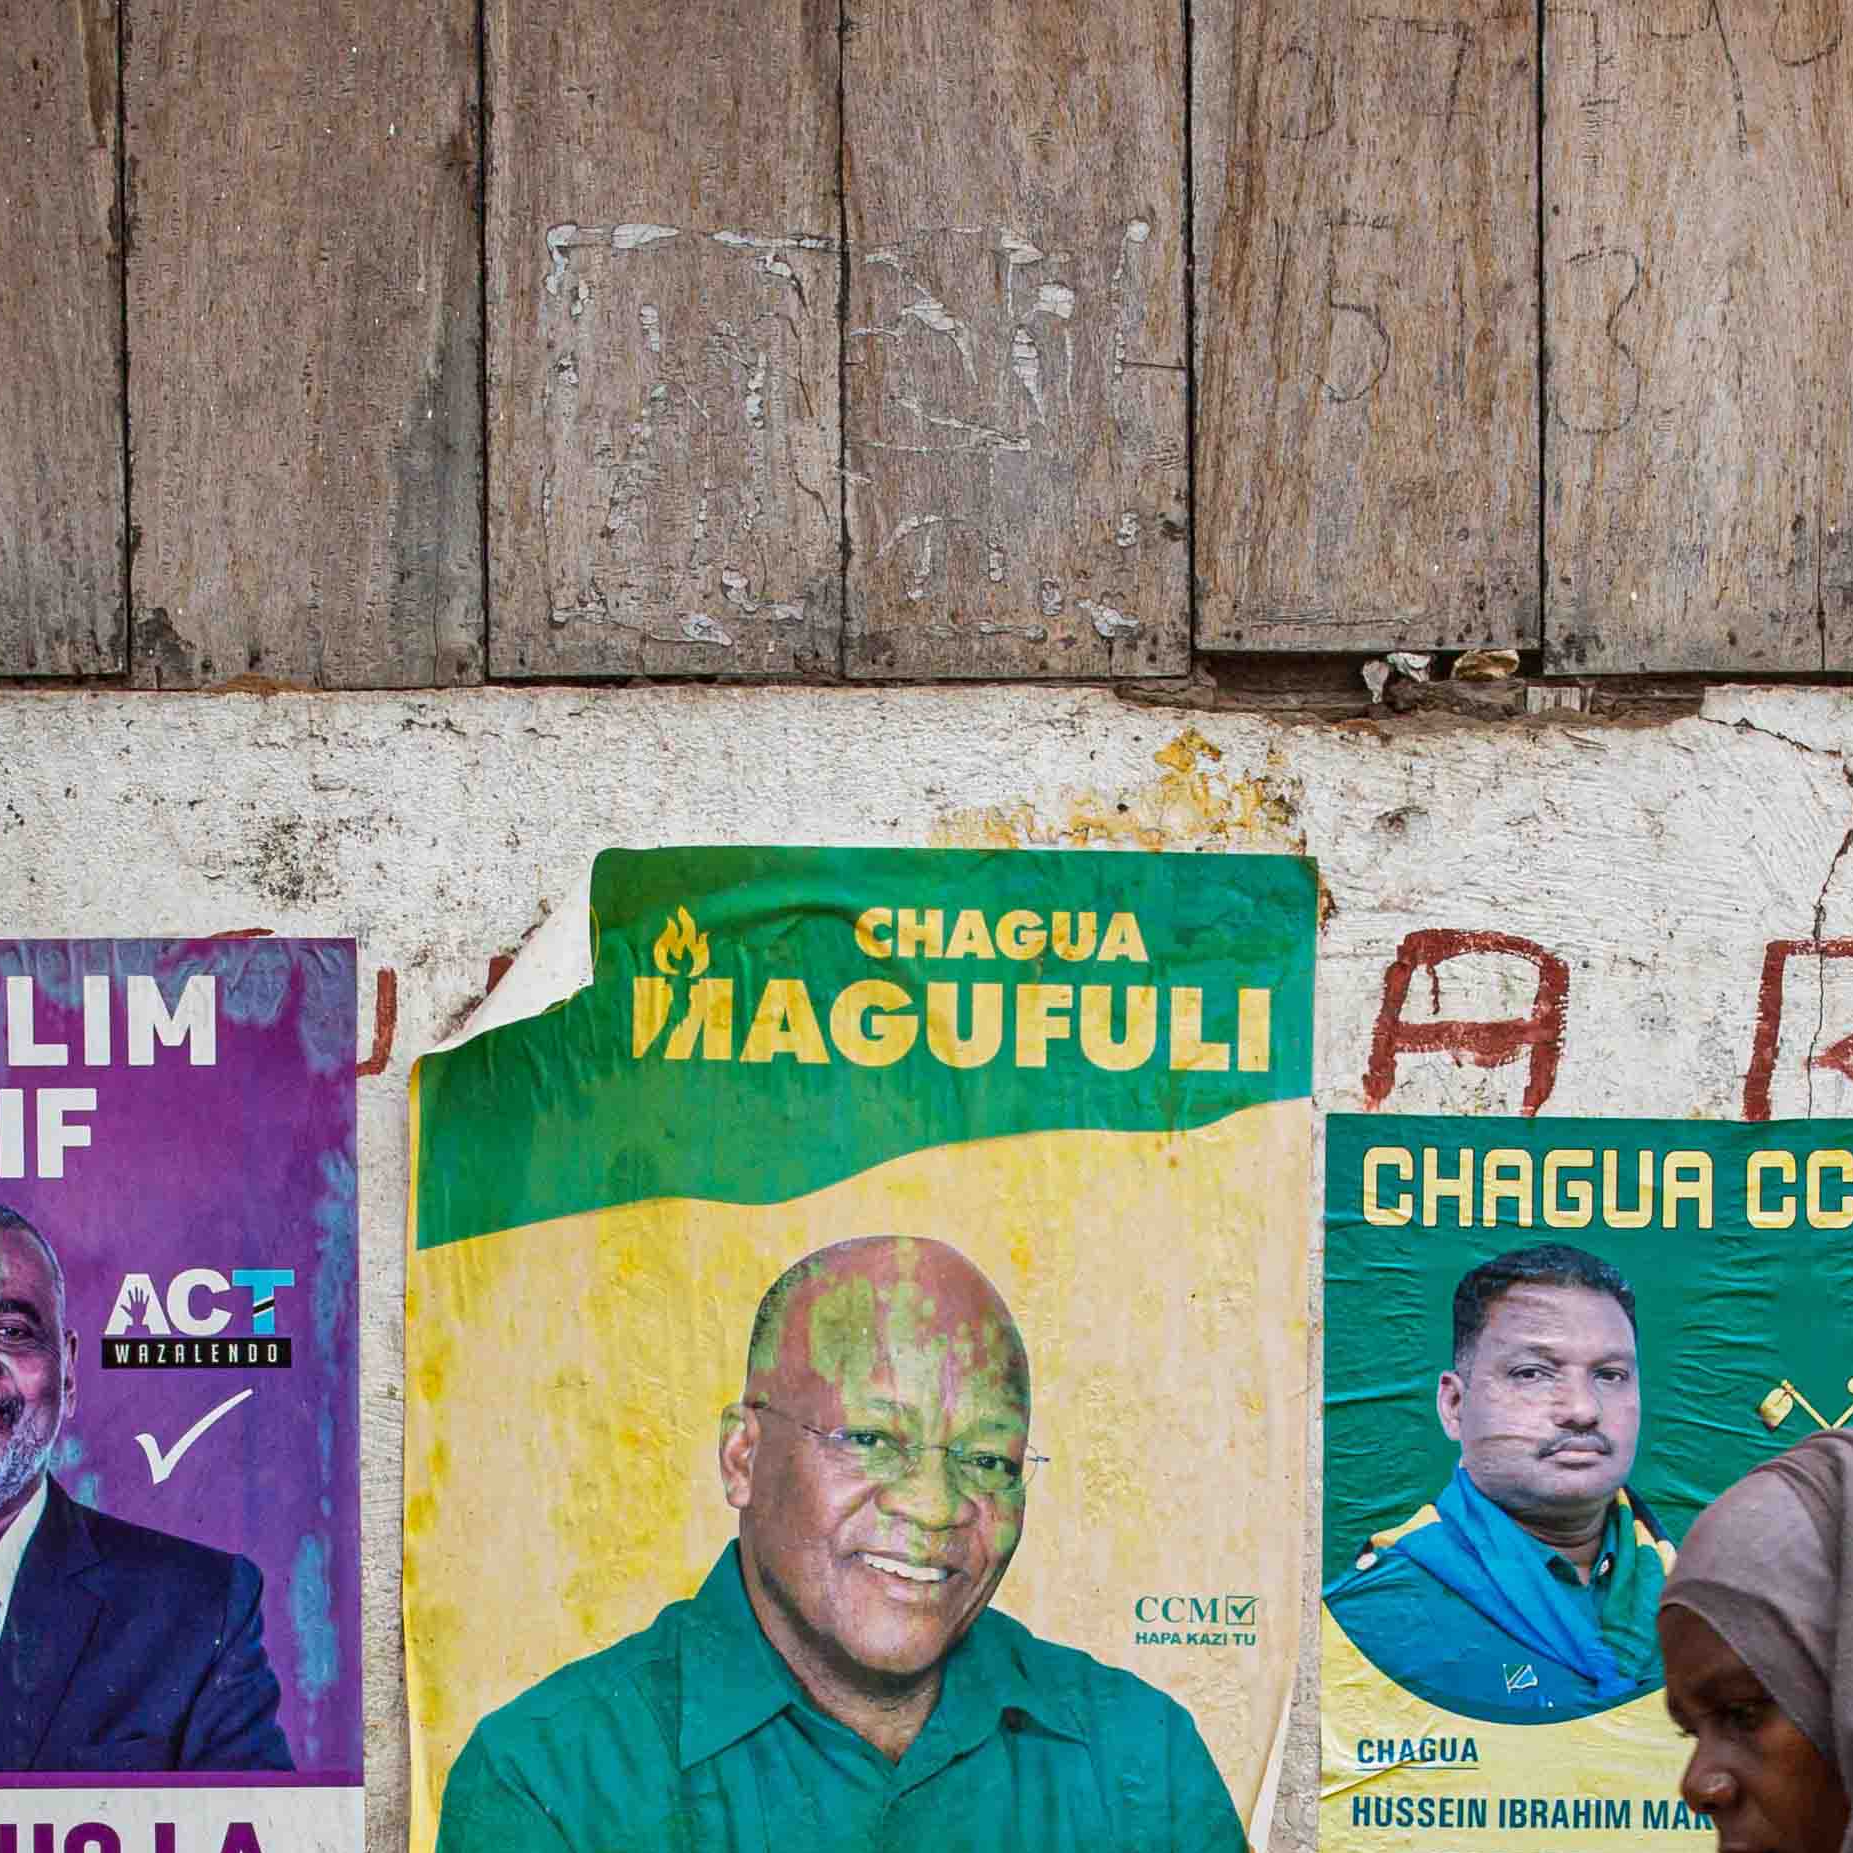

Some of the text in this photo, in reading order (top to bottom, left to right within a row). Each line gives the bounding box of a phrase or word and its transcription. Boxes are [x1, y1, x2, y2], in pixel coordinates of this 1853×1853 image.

[854, 905, 1150, 963] CHAGUA
[632, 975, 1272, 1073] MAGUFULI
[1363, 1146, 1714, 1229] CHAGUA
[104, 1267, 295, 1336] ACT
[114, 1342, 281, 1365] WAZALENDO
[1134, 1595, 1220, 1624] CCM
[1135, 1632, 1257, 1646] HAPA KAZI TU
[1356, 1737, 1479, 1764] CHAGUA
[1352, 1796, 1487, 1829] HUSSEIN
[1498, 1798, 1632, 1830] IBRAHIM
